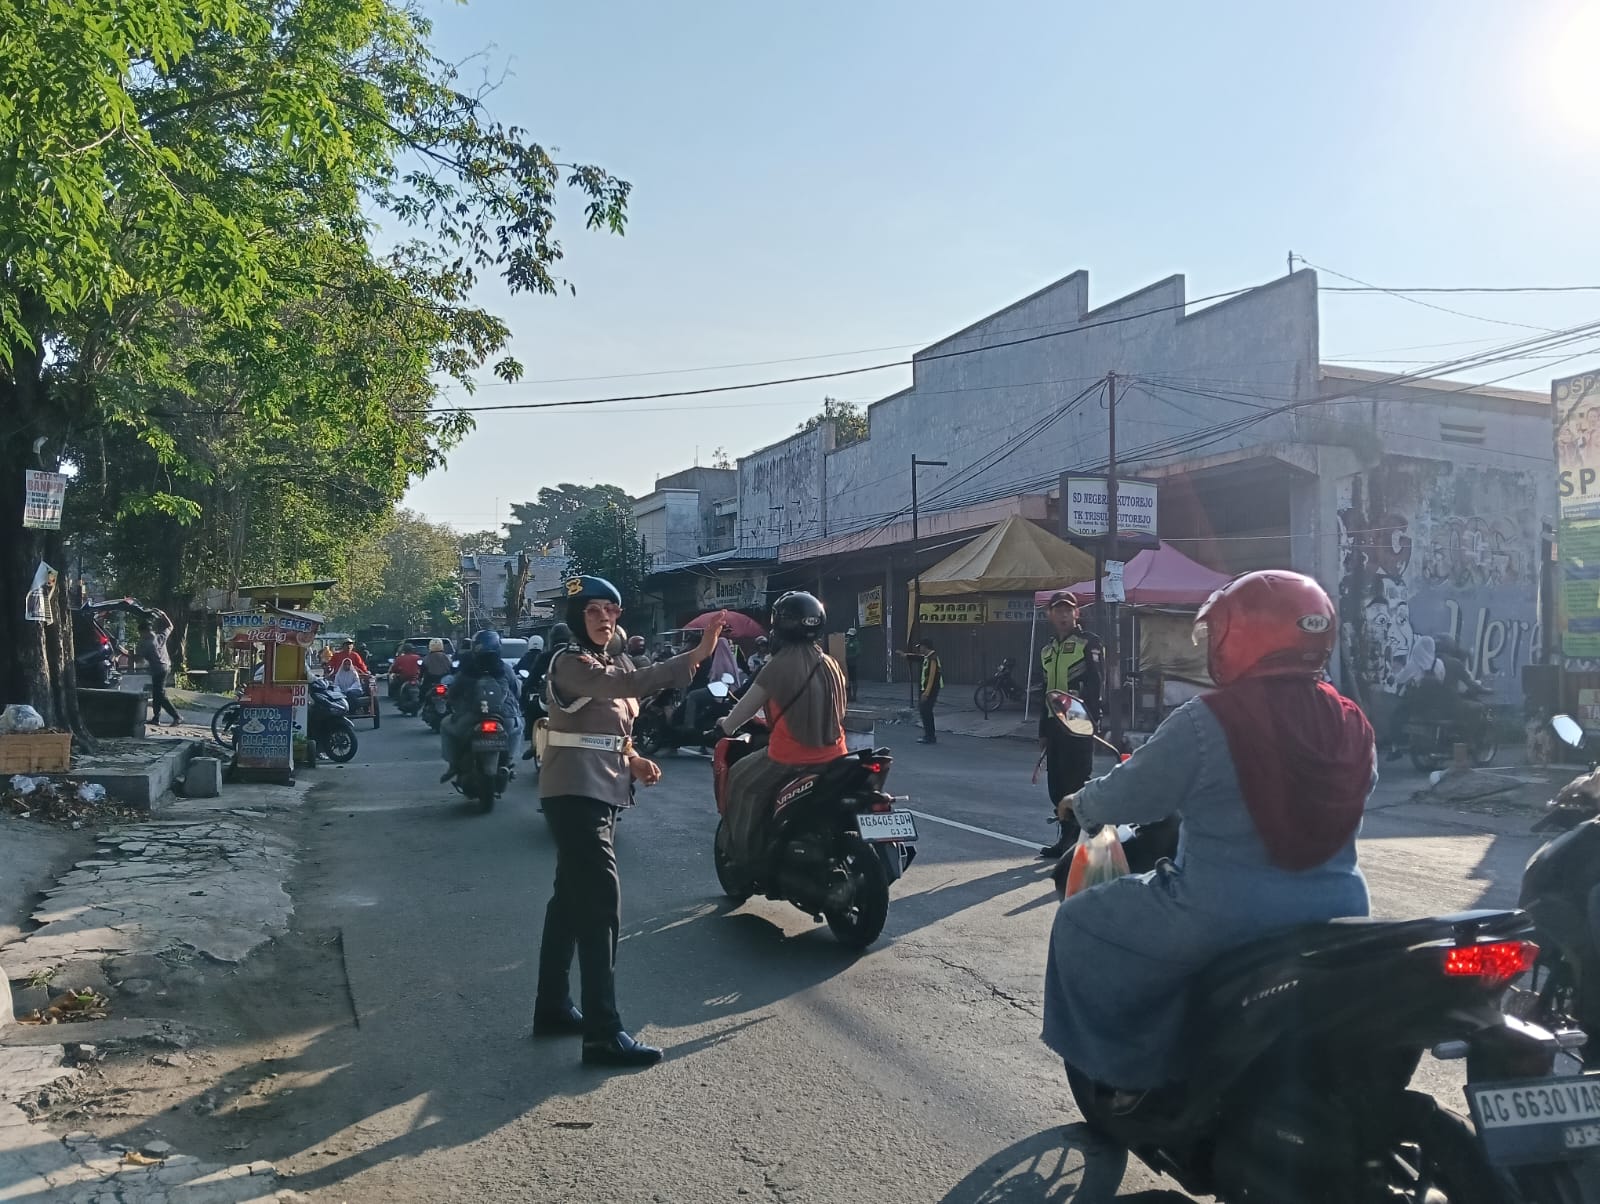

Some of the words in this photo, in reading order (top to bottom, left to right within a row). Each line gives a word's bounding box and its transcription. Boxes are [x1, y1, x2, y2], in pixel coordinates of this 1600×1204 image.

[1072, 492, 1082, 503] SD
[1073, 511, 1083, 520] TK
[223, 615, 262, 626] PENTOL
[243, 707, 281, 719] PENTOL
[1481, 1094, 1510, 1123] AG
[1512, 1088, 1567, 1118] 6630
